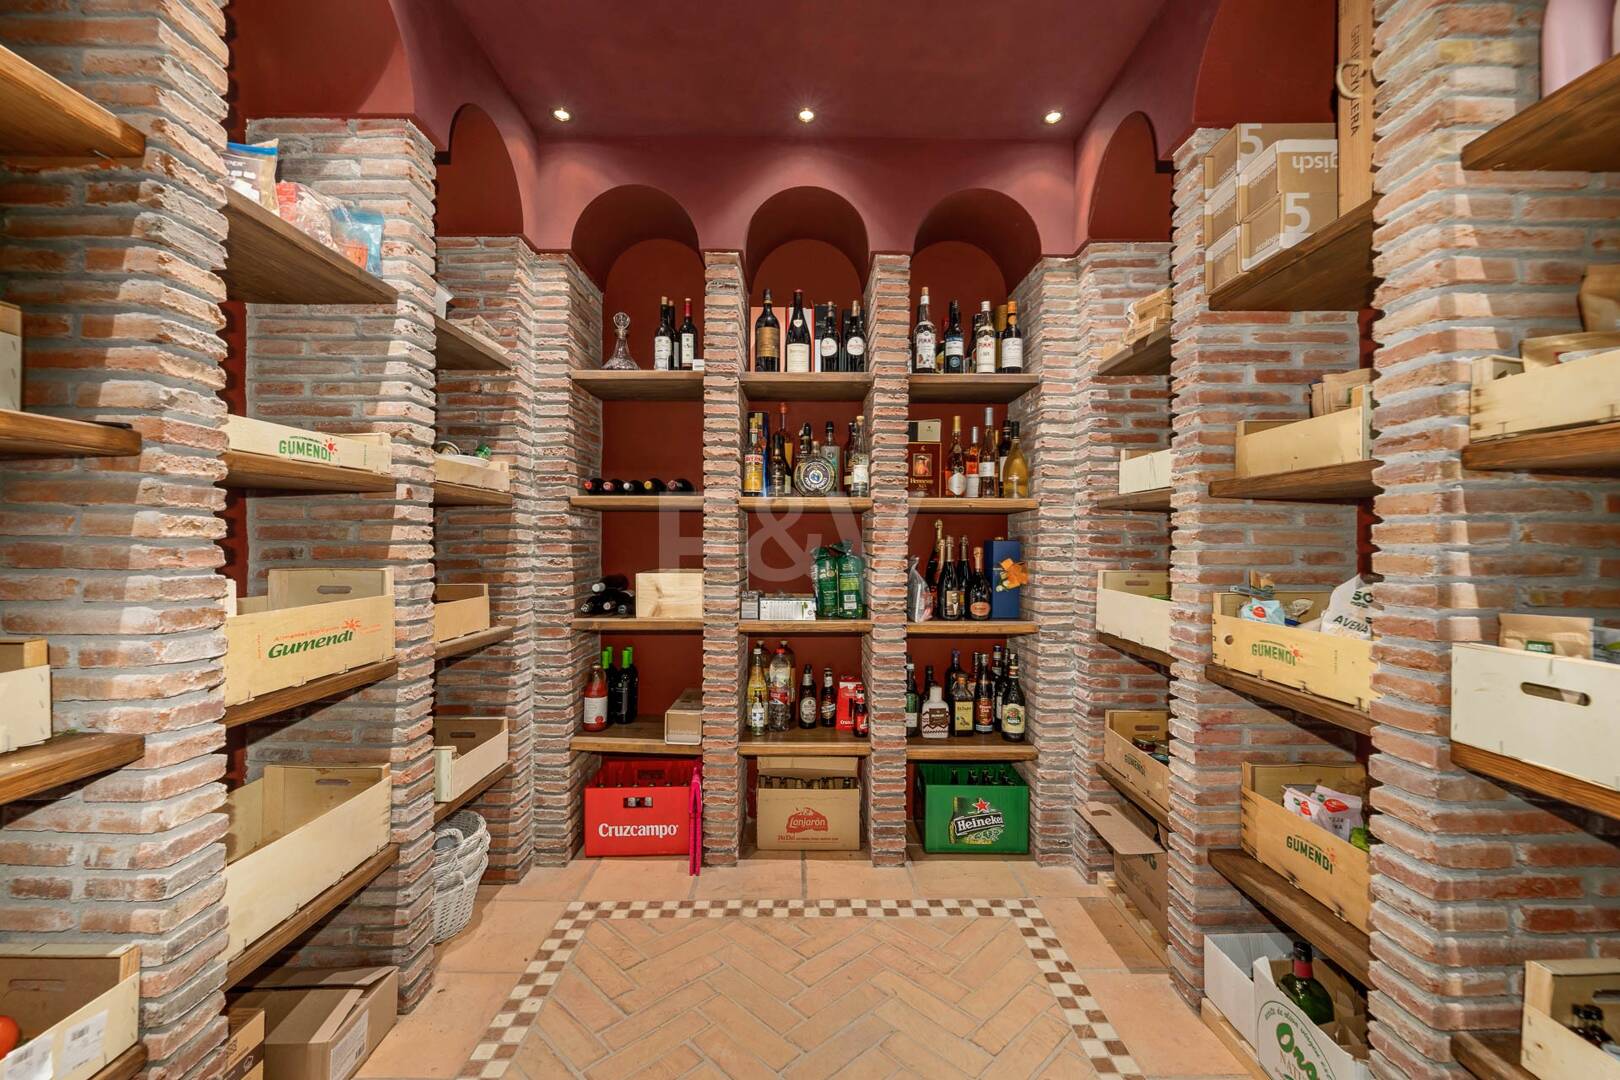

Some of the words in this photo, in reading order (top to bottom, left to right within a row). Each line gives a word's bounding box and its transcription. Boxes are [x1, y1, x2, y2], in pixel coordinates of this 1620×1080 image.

[1239, 123, 1264, 157] 5
[1285, 192, 1311, 234] 5
[278, 439, 332, 462] GUMENDI
[1333, 615, 1369, 634] AVENA
[267, 629, 354, 659] Gumendi
[1251, 643, 1297, 667] GUMENDI
[598, 822, 677, 839] Cruzcampo
[1286, 835, 1334, 875] GUMENDI
